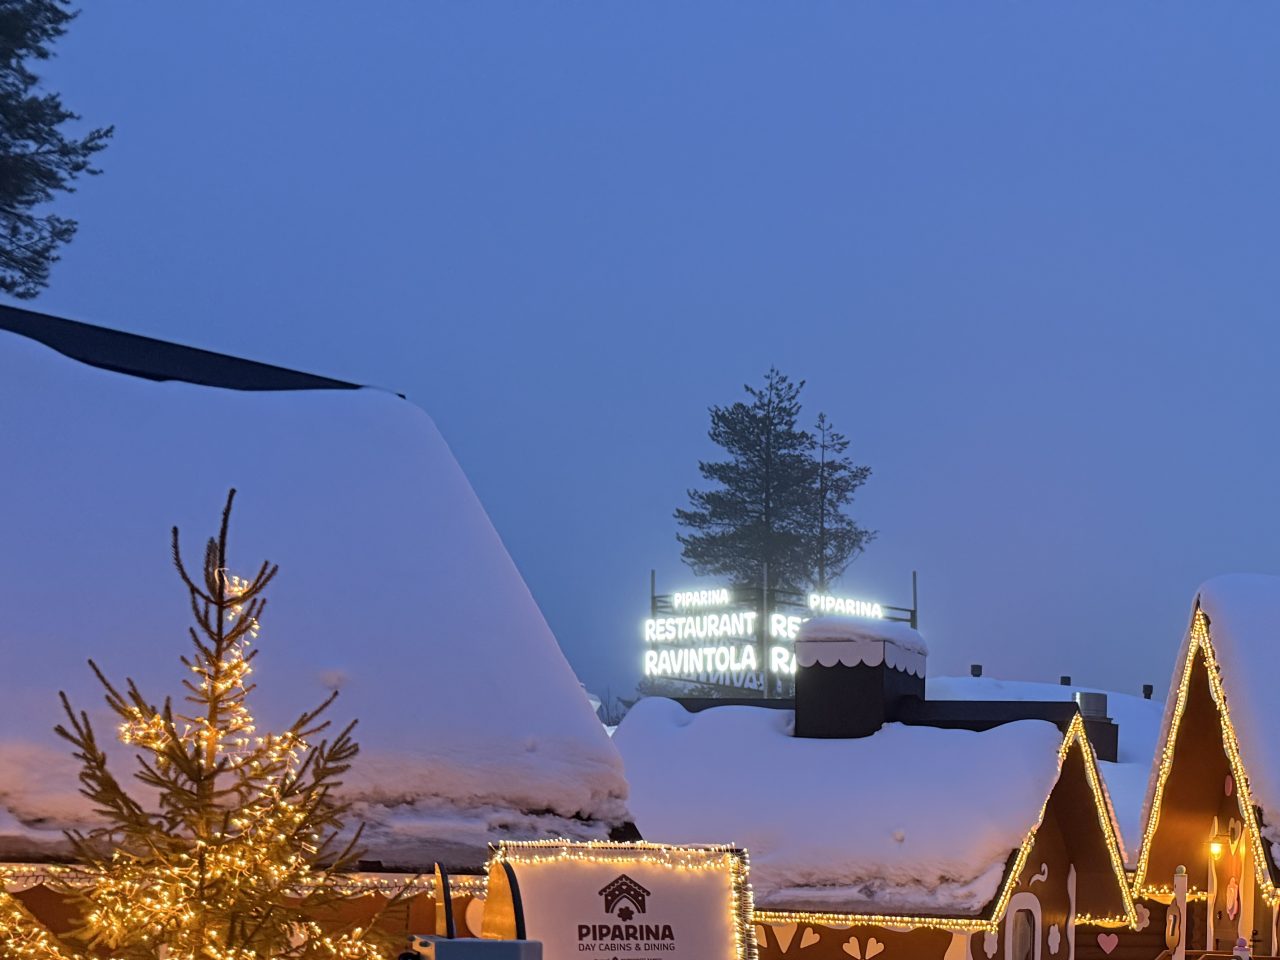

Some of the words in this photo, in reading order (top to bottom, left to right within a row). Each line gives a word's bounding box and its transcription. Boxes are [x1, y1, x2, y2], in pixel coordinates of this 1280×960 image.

[673, 589, 729, 608] PIPARINA
[809, 594, 883, 618] PIPARINA
[645, 612, 756, 641] RESTAURANT
[645, 645, 757, 675] RAVINTOLA
[578, 924, 675, 941] PIPARINA
[578, 943, 596, 952] DAY
[598, 943, 632, 951] CABINS
[634, 943, 641, 951] &
[644, 943, 676, 951] DINING
